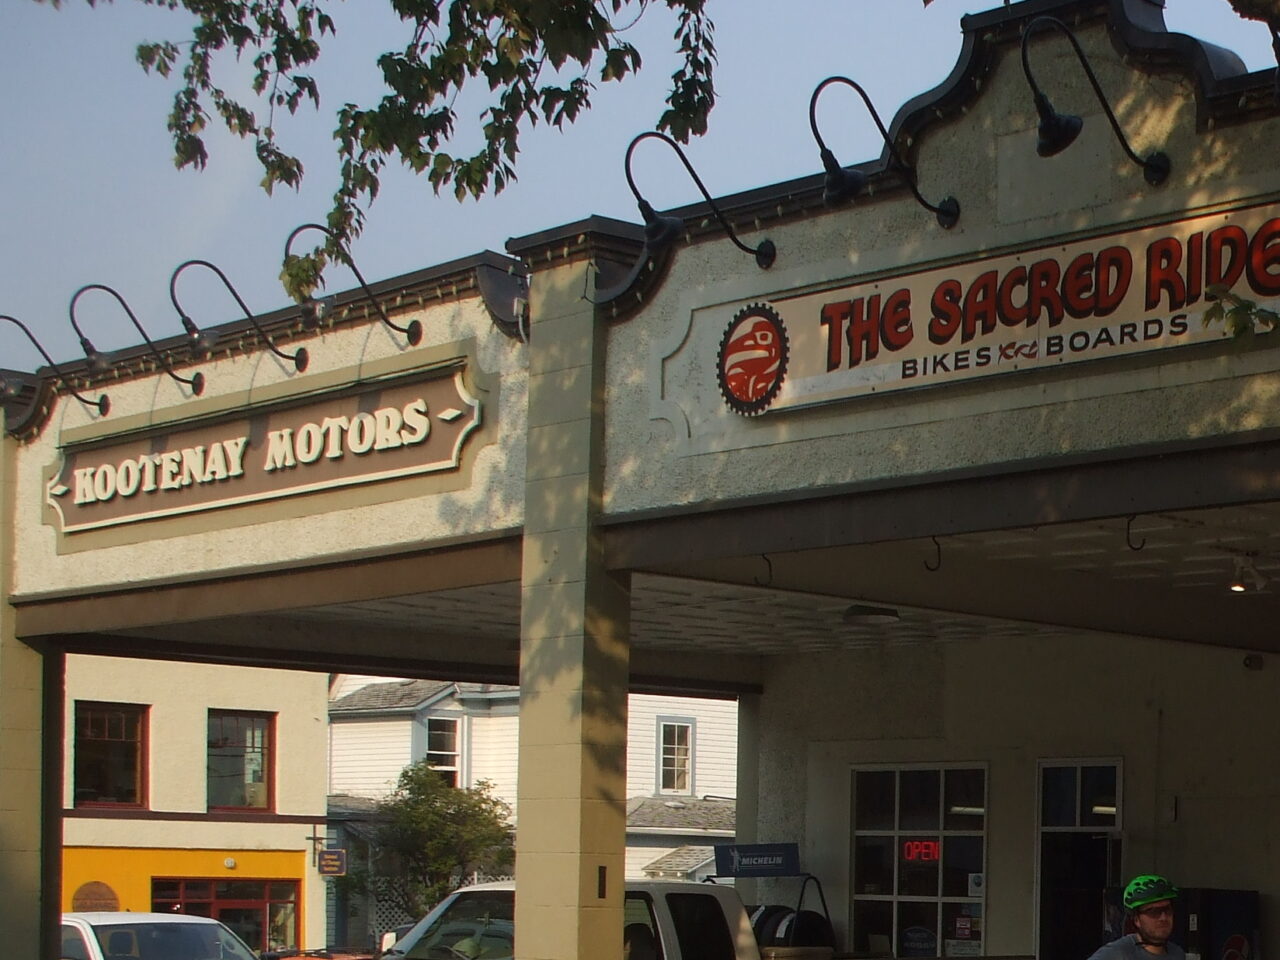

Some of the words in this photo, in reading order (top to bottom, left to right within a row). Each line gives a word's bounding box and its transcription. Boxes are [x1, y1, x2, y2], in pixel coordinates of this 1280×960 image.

[820, 288, 914, 373] THE
[927, 245, 1133, 345] SACRED
[901, 346, 992, 379] BIKES
[1045, 314, 1189, 357] BOARDS
[73, 437, 248, 505] KOOTENAY
[263, 398, 431, 473] MOTORS
[741, 856, 784, 866] MICHELIN
[904, 841, 941, 861] OPEN
